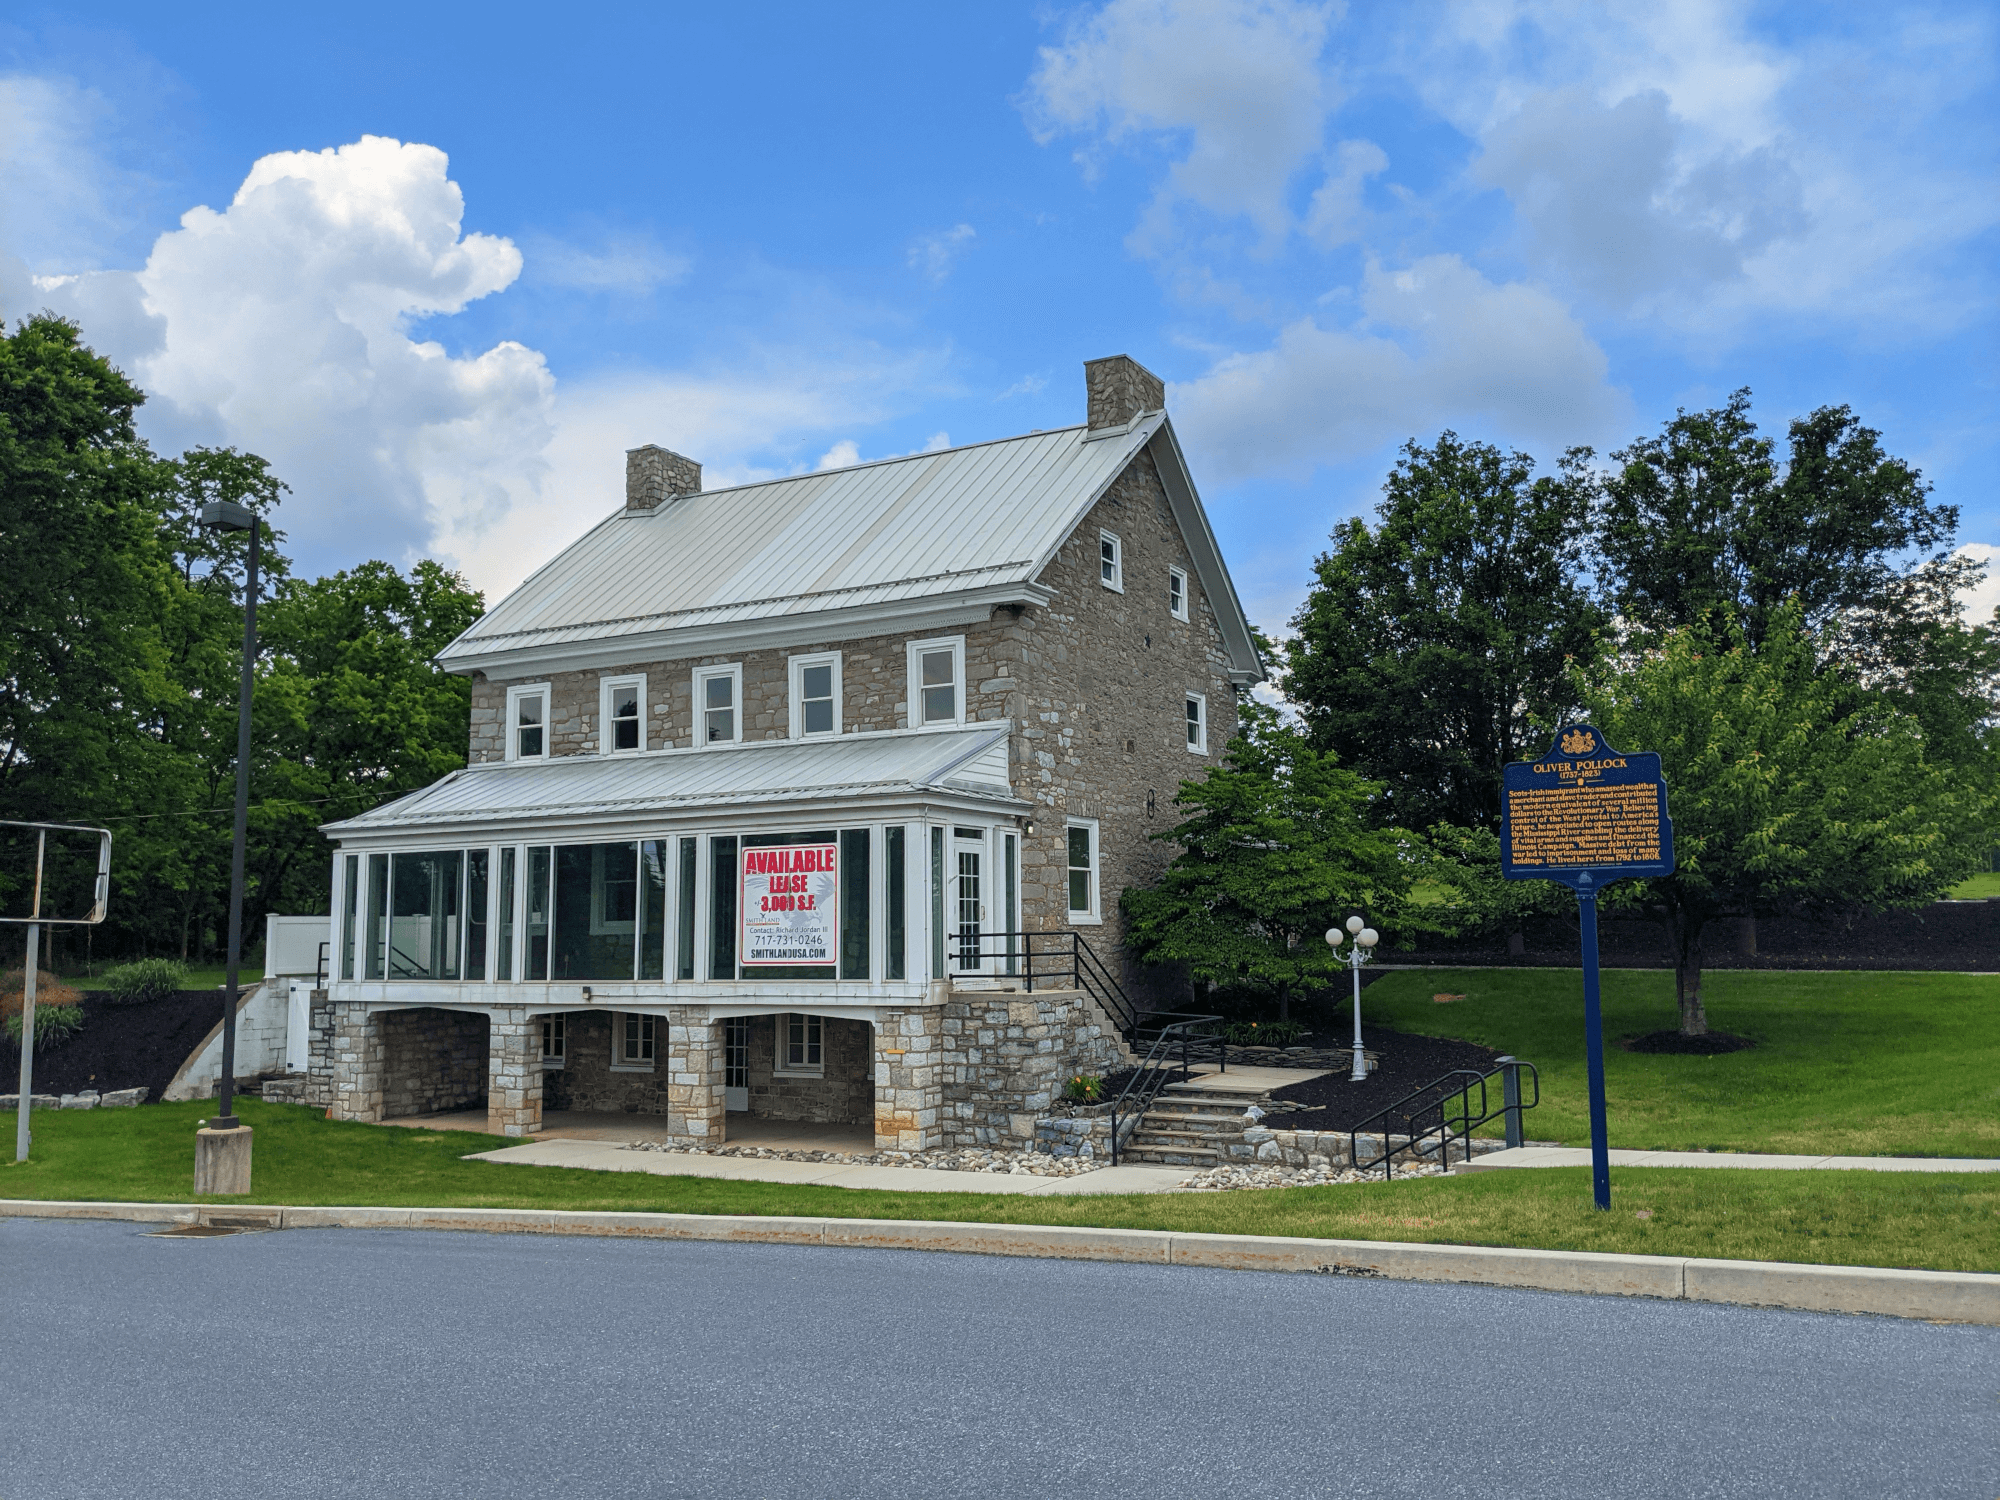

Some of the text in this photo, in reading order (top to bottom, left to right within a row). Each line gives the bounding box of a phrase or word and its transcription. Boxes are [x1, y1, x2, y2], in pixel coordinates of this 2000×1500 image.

[1533, 758, 1628, 773] OLIVER POLLOCK
[1545, 787, 1580, 796] immigrant
[1595, 784, 1625, 792] amassed
[1625, 782, 1648, 790] wealth
[1514, 796, 1545, 804] merchant
[1600, 791, 1614, 799] and
[1614, 789, 1658, 798] contributed
[1510, 803, 1522, 811] the
[1523, 802, 1550, 810] modern
[1551, 800, 1591, 809] equivalent
[1601, 797, 1629, 806] several
[1630, 796, 1658, 804] million
[1510, 810, 1534, 818] dollars
[1553, 806, 1605, 815] Revolutionary
[1605, 805, 1622, 813] War.
[1622, 803, 1658, 812] Believing
[1510, 816, 1538, 824] control
[1563, 814, 1580, 822] West
[1582, 812, 1610, 820] pivotal
[1621, 810, 1659, 819] America's
[1547, 820, 1584, 830] negotiated
[1593, 820, 1612, 828] open
[1638, 817, 1659, 826] along
[1523, 829, 1560, 838] Mississippi
[1561, 828, 1580, 836] River
[1581, 826, 1613, 835] enabling
[1628, 825, 1659, 833] delivery
[1511, 837, 1519, 845] of
[1520, 836, 1536, 844] vital
[1569, 834, 1598, 843] supplies
[1613, 832, 1646, 840] financed
[1537, 843, 1577, 851] Campaign.
[1578, 841, 1607, 849] Massive
[1546, 848, 1597, 858] imprisonment
[1598, 847, 1612, 855] and
[1628, 846, 1637, 854] of
[1638, 847, 1661, 855] many
[745, 849, 834, 875] AVAILABLE
[1512, 857, 1545, 865] holdings.
[1557, 855, 1576, 863] lived
[1633, 853, 1642, 861] to
[769, 874, 808, 894] LEASE
[797, 894, 817, 911] S.F.
[775, 926, 799, 934] Richard
[800, 925, 821, 934] Jordan
[755, 934, 823, 946] 717-731-0246
[751, 948, 826, 959] SMITHLANDUSA.COM
